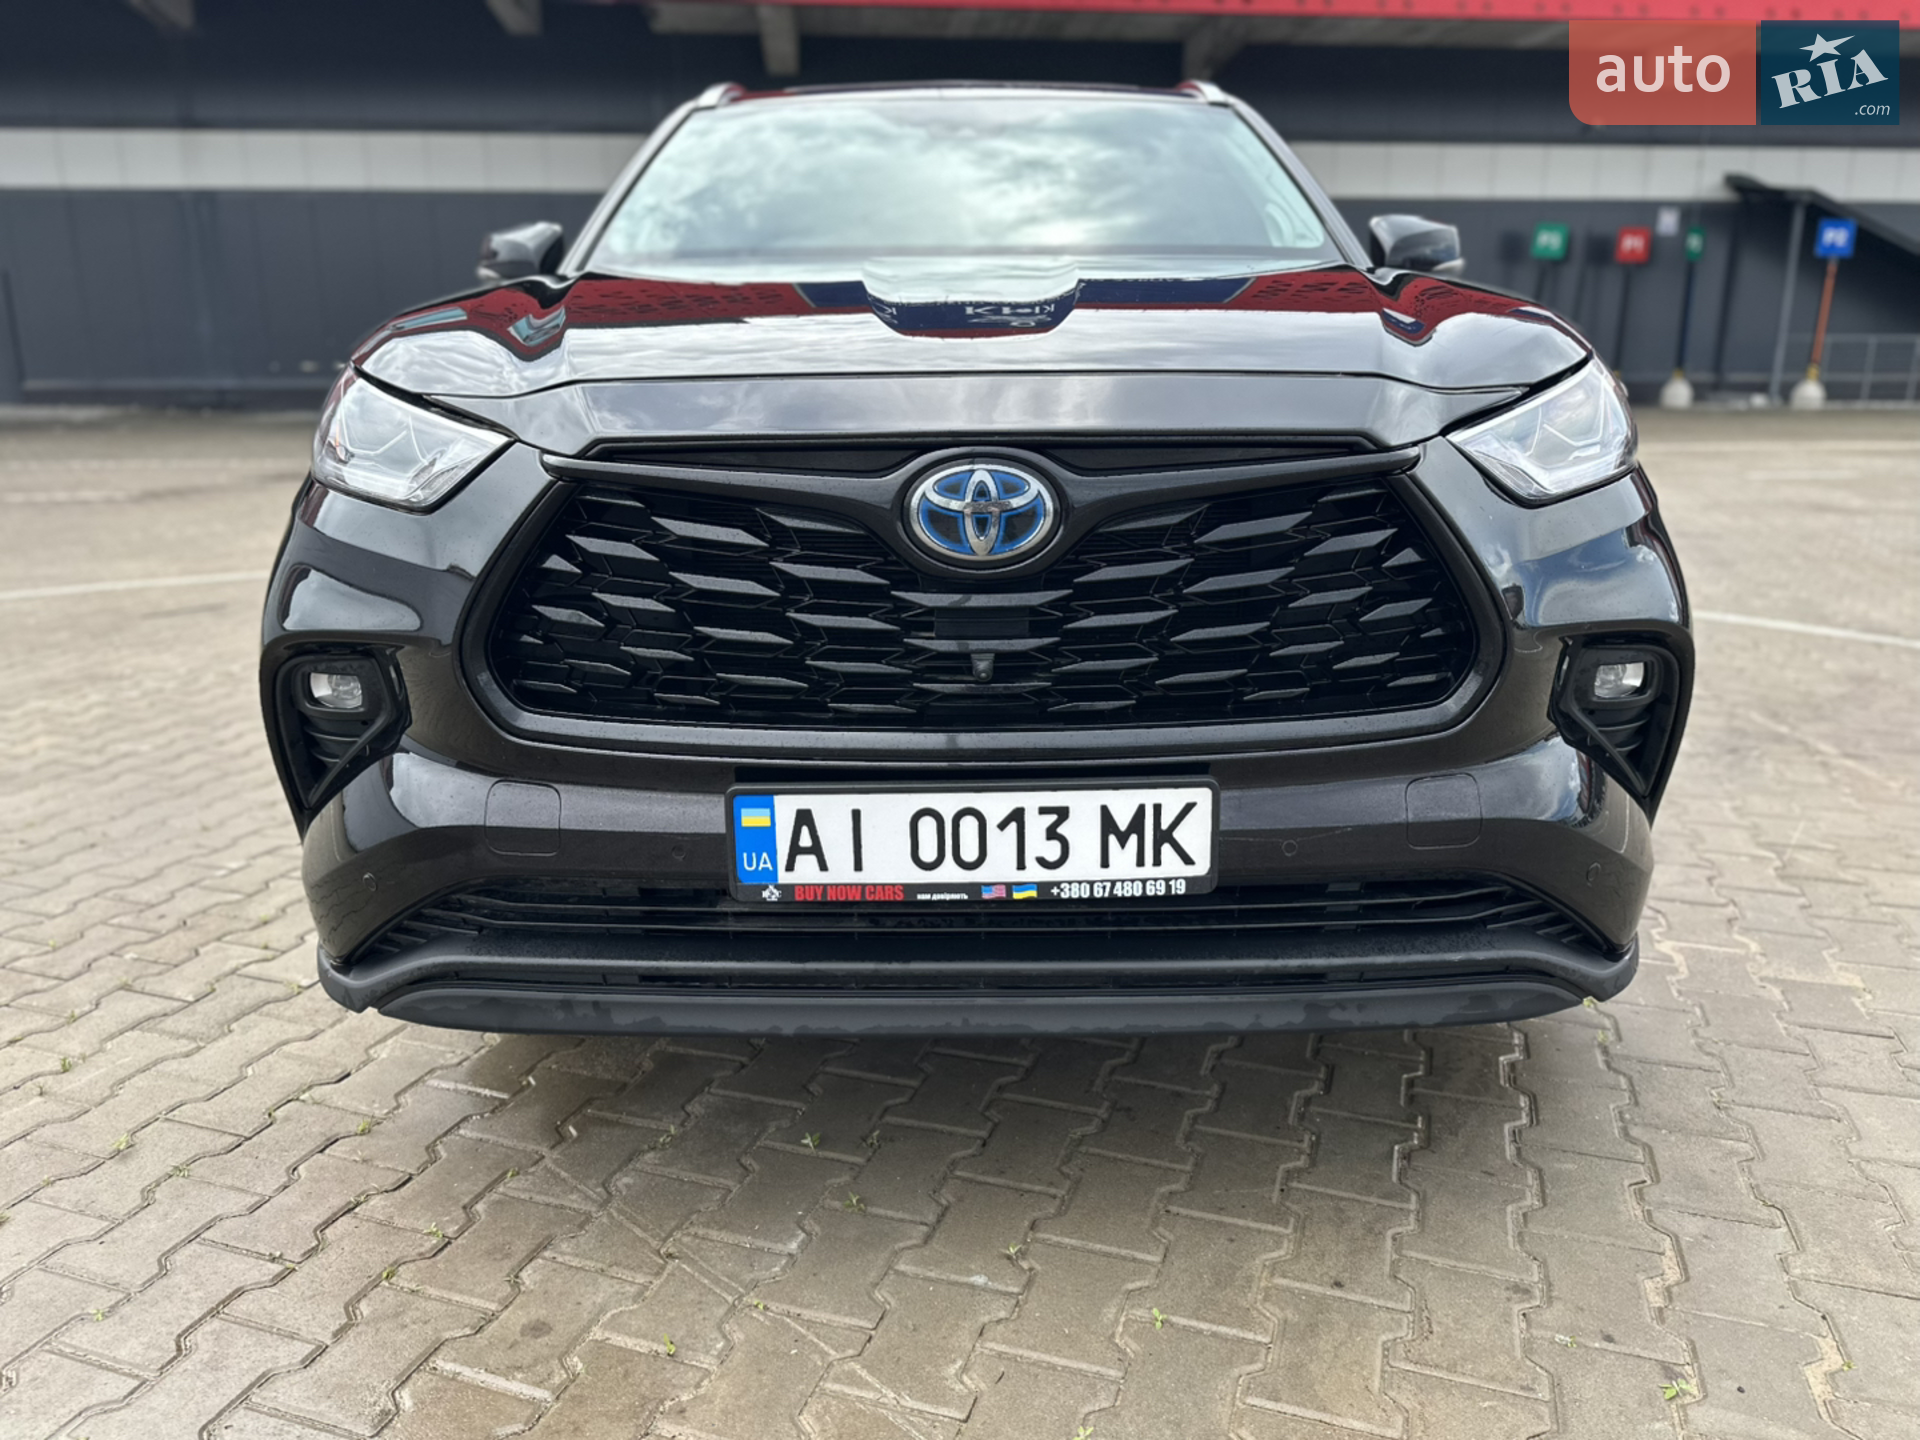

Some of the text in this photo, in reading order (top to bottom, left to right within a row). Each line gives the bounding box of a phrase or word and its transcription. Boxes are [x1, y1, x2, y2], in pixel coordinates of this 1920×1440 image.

[785, 802, 1198, 872] AI 0013 MK
[743, 852, 774, 871] UA
[794, 885, 824, 901] BUY
[826, 885, 863, 901] NOW
[865, 884, 905, 901] CARS
[1050, 878, 1186, 898] +380 67 480 69 19
